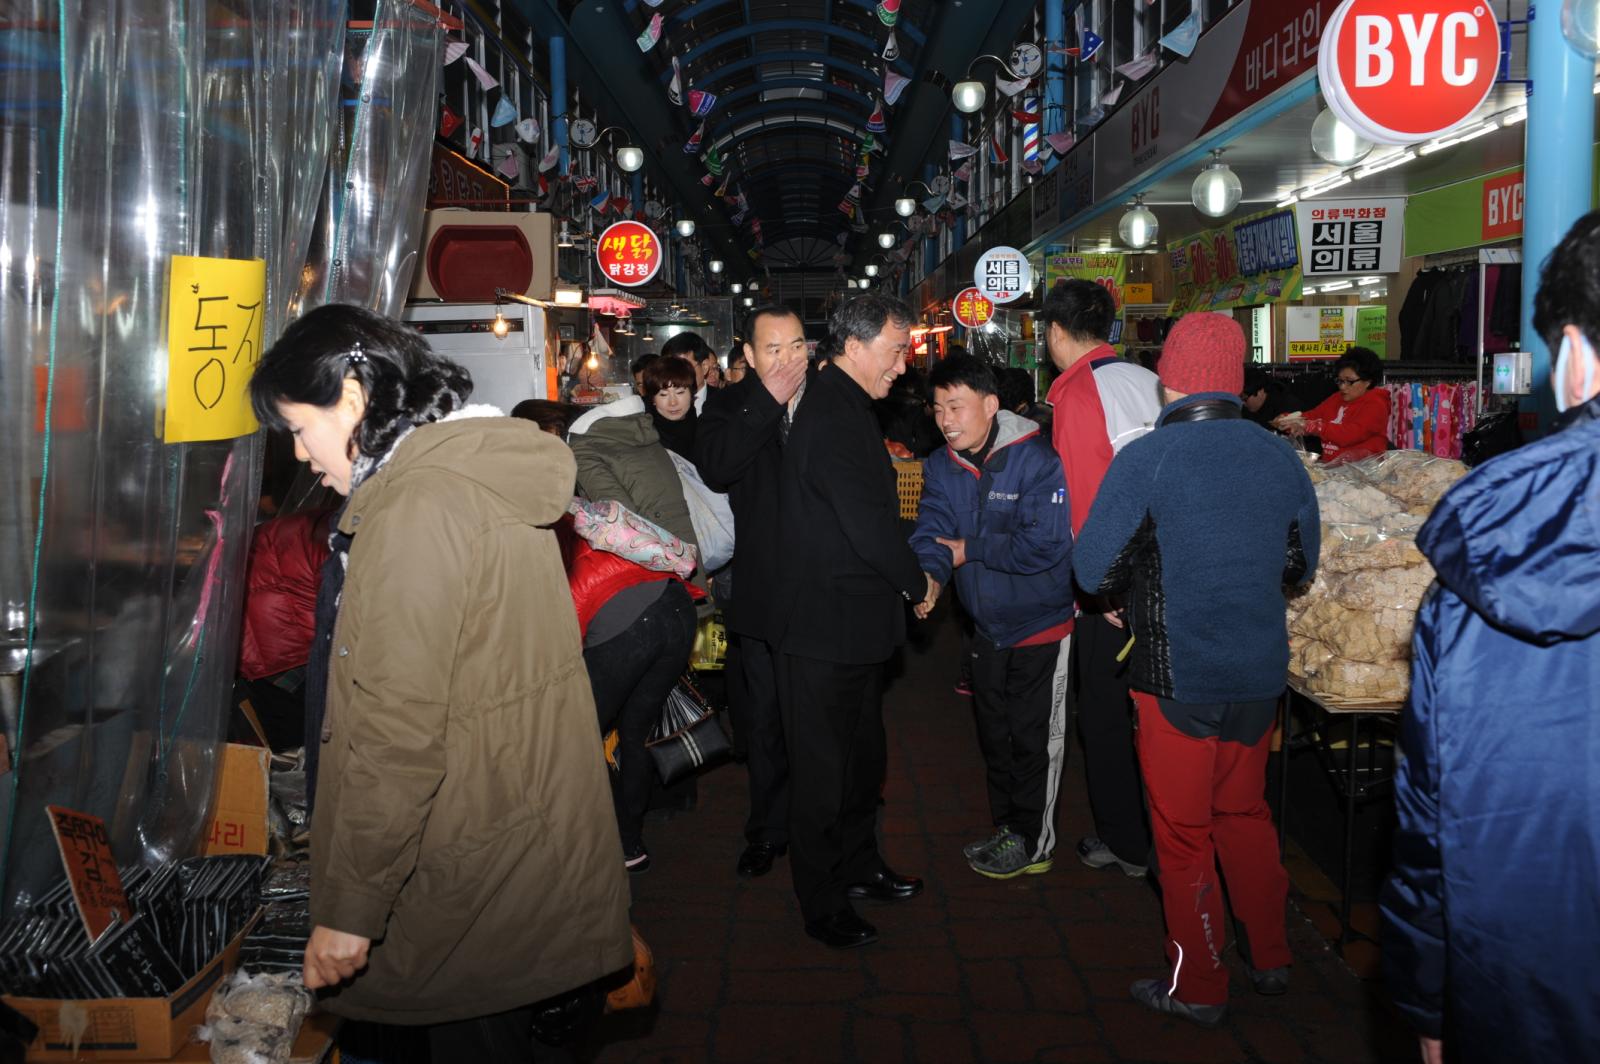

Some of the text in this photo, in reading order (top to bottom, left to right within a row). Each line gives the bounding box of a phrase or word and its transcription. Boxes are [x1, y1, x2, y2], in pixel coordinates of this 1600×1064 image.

[1355, 11, 1479, 88] BYC
[1131, 86, 1160, 154] BYC
[1311, 206, 1387, 221] 의류백화점
[1314, 221, 1380, 244] 서울
[602, 233, 654, 261] 생닭
[608, 263, 649, 276] 닭강정
[987, 260, 1019, 275] 서울
[1314, 249, 1377, 270] 의류
[987, 276, 1019, 291] 의류
[960, 300, 989, 321] 족발
